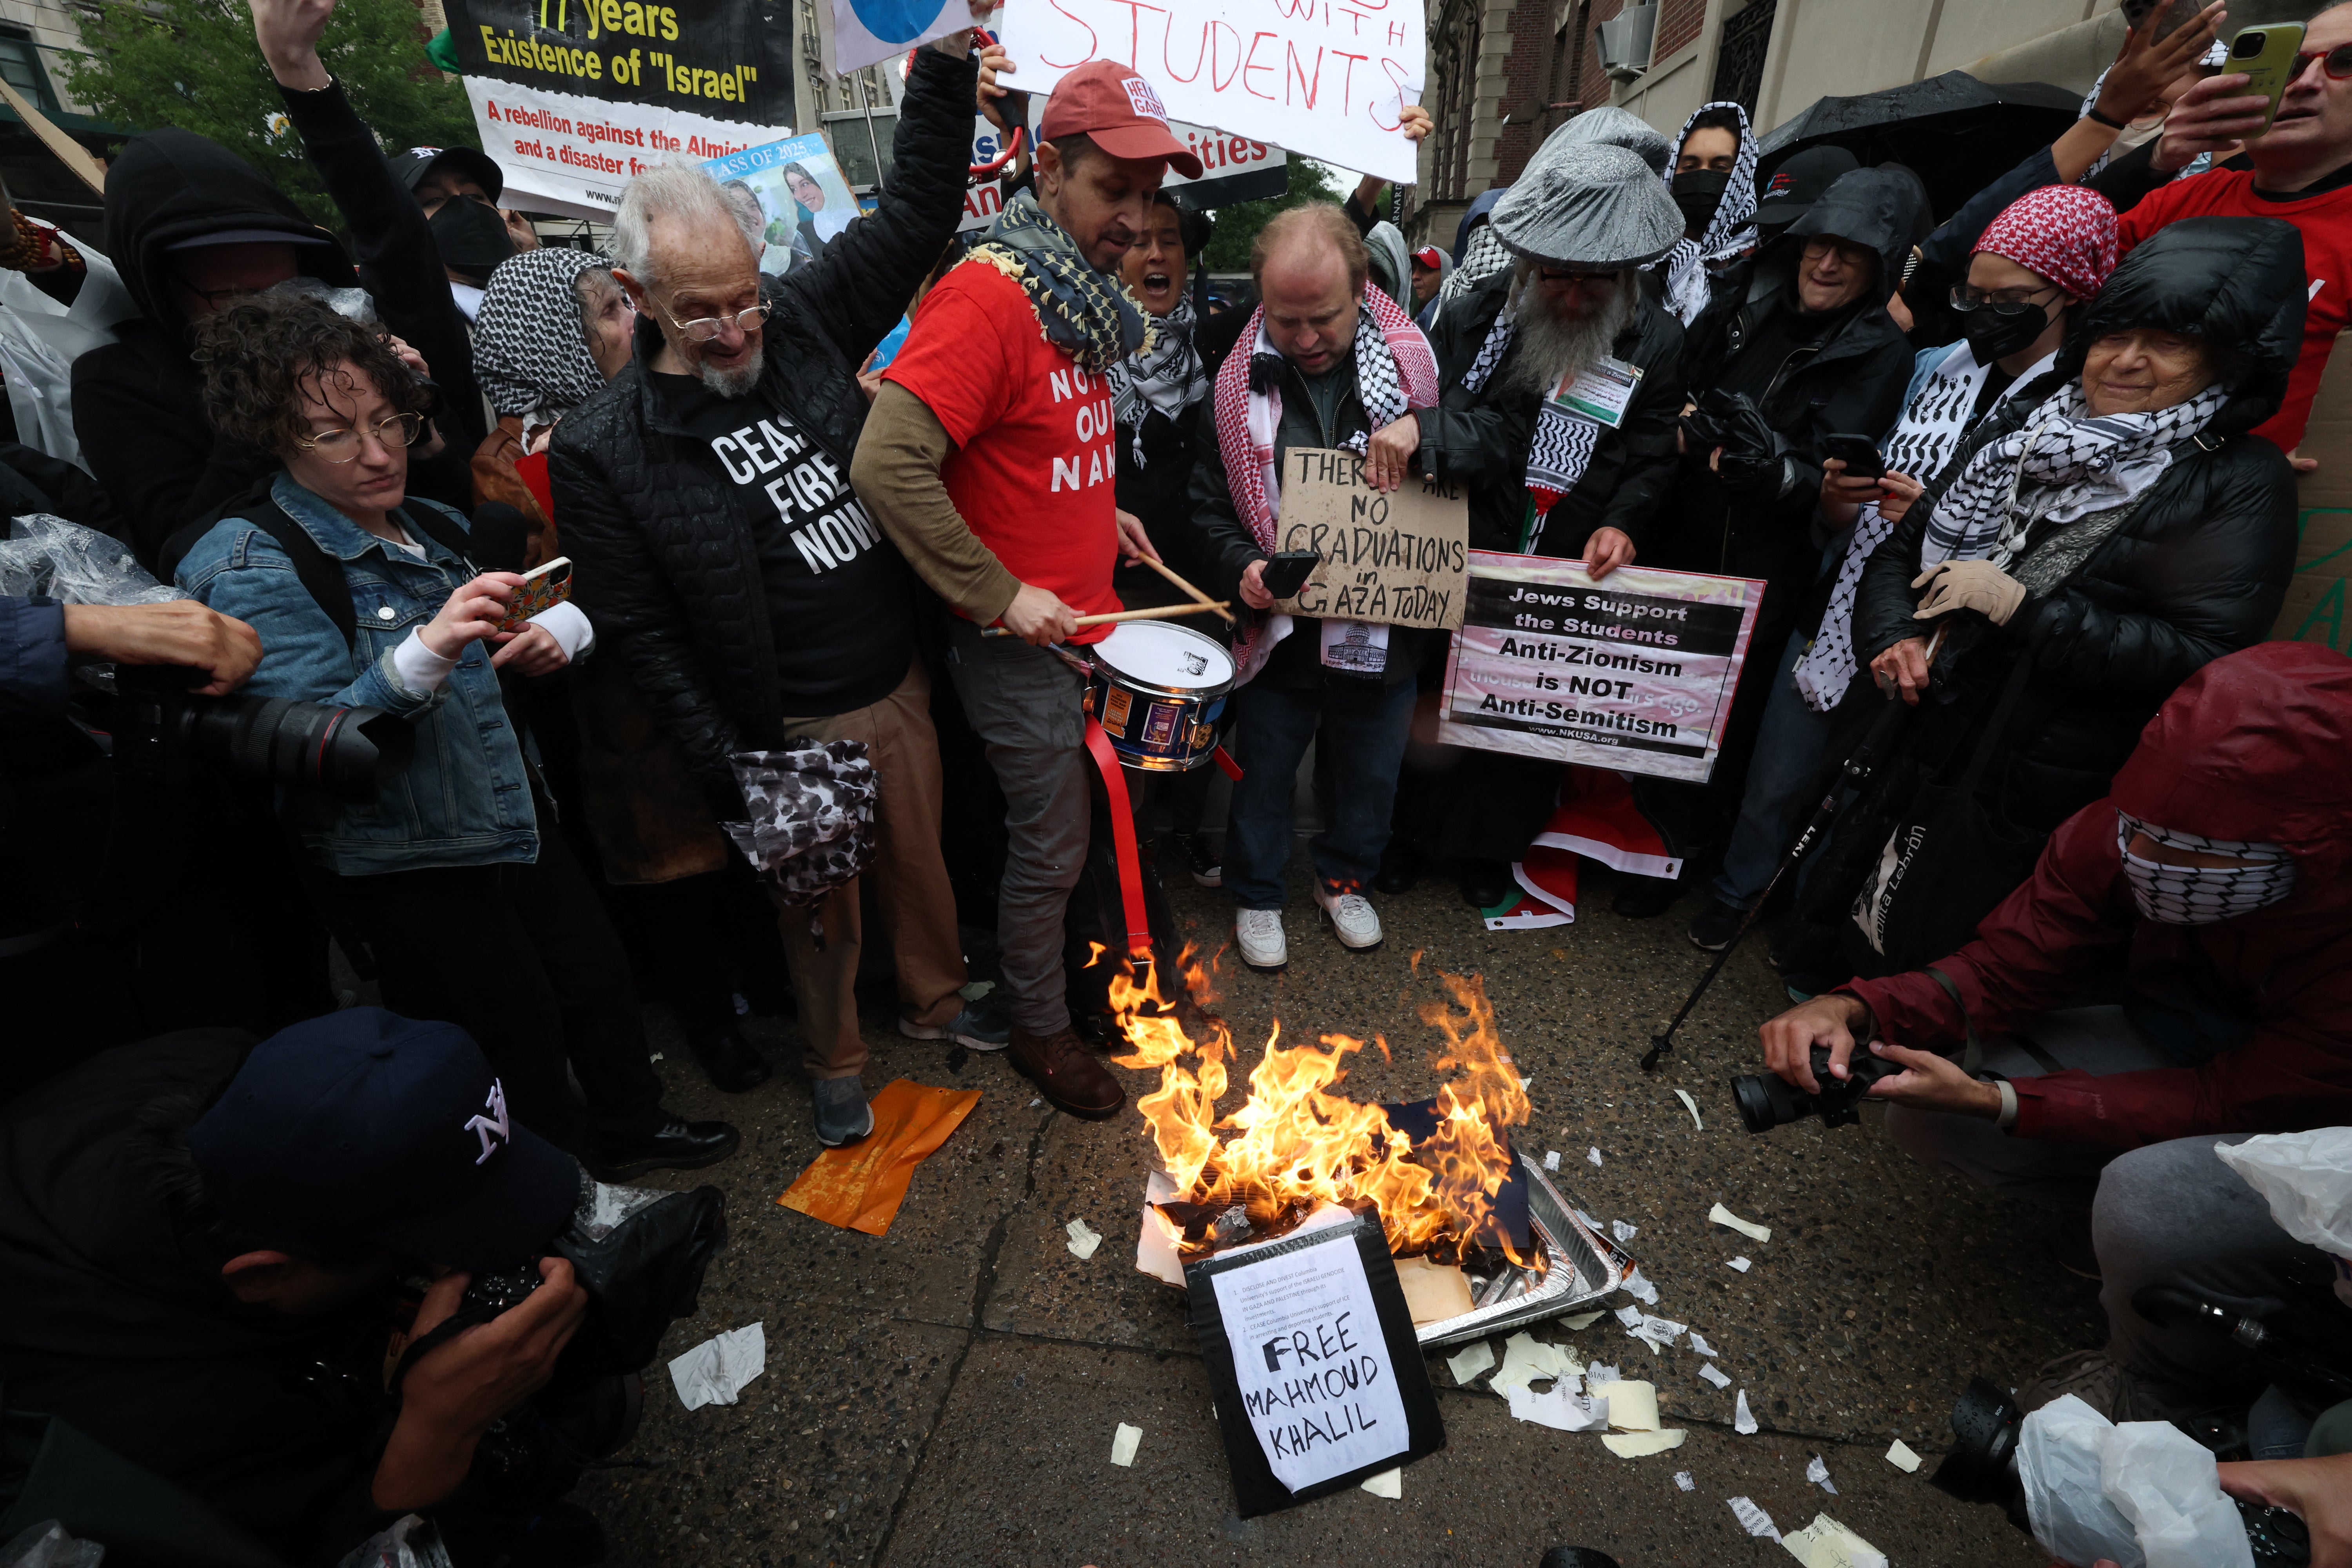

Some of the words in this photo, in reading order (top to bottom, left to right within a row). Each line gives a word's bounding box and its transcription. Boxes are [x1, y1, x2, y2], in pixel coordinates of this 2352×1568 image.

[587, 0, 679, 40] years
[479, 25, 601, 80] Existence
[612, 48, 641, 86] of
[650, 51, 757, 103] "Israel"
[1040, 0, 1408, 131] STUDENTS
[1127, 81, 1160, 105] HELL
[1134, 99, 1167, 121] GATE
[487, 101, 502, 122] A
[505, 105, 572, 134] rebellion
[577, 120, 643, 147] against
[650, 130, 681, 152] the
[686, 135, 747, 159] Almi
[514, 139, 543, 160] and
[546, 145, 556, 160] a
[560, 144, 624, 175] disaster
[706, 156, 748, 178] LASS
[750, 148, 773, 167] OF
[775, 140, 807, 160] 2025
[1188, 130, 1267, 171] ities
[1392, 183, 1402, 229] ARNARD
[1611, 371, 1632, 383] Zionist
[1076, 397, 1115, 443] OU
[711, 414, 811, 485] CEAS
[764, 451, 851, 524] FIRE
[1294, 452, 1379, 489] THER
[1351, 494, 1388, 525] NO
[789, 498, 881, 575] NOW
[1285, 524, 1465, 573] GRADUATIONS
[1357, 571, 1377, 585] in
[1298, 583, 1387, 616] GAZA
[1509, 588, 1575, 608] Jews
[1584, 595, 1688, 622] Support
[1515, 613, 1555, 630] the
[1563, 619, 1679, 646] Students
[1499, 638, 1682, 677] Anti-Zionism
[1536, 673, 1559, 691] is
[1569, 676, 1633, 700] NOT
[1479, 693, 1678, 738] Anti-Semitism
[1528, 726, 1619, 746] www.NKUSA.org
[1792, 825, 1817, 858] LEKI
[1889, 825, 1926, 891] Lebrón
[1240, 1290, 1268, 1304] University's
[1269, 1285, 1288, 1296] support
[1302, 1274, 1320, 1285] ISRAELI
[1321, 1267, 1345, 1280] GENOCIDE
[1242, 1282, 1265, 1293] DISCLOSE
[1266, 1279, 1277, 1287] AND
[1278, 1273, 1294, 1283] DIVEST
[1295, 1267, 1318, 1278] Columbia
[1245, 1308, 1276, 1322] investments.
[1249, 1302, 1263, 1311] GAZA
[1276, 1290, 1301, 1303] PALESTINE
[1300, 1286, 1320, 1296] through
[1250, 1321, 1266, 1330] CEASE
[1267, 1314, 1290, 1326] Columbia
[1290, 1305, 1318, 1319] University's
[1318, 1300, 1336, 1311] support
[1255, 1328, 1278, 1339] arresting
[1288, 1317, 1312, 1331] deporting
[1312, 1312, 1334, 1322] students.
[1262, 1311, 1359, 1374] FREE
[1245, 1355, 1378, 1417] MAHMOUD
[1581, 1396, 1591, 1414] ITY
[1995, 1404, 2004, 1417] SONY
[1270, 1402, 1377, 1460] KHALIL
[1744, 1509, 1759, 1523] IPLOMA
